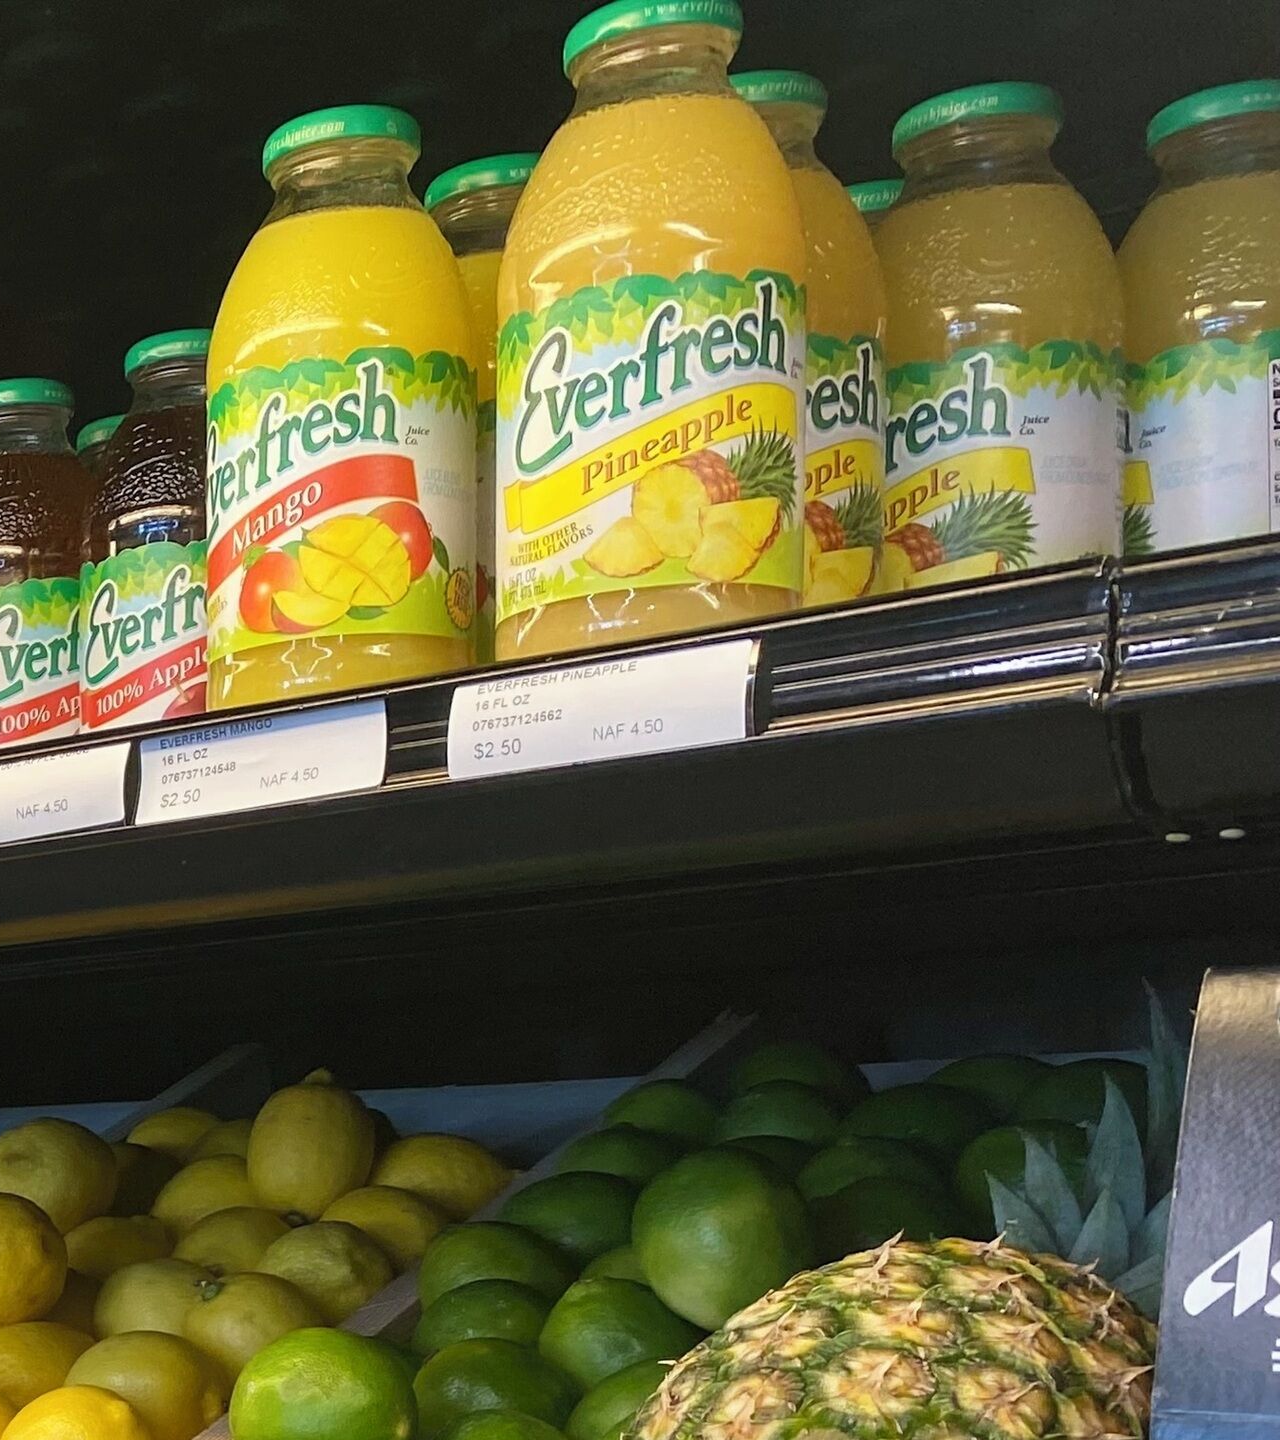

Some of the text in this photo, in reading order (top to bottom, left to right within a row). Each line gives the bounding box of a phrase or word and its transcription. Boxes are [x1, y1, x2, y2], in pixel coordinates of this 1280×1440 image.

[517, 278, 785, 474] Everfresh
[406, 426, 431, 437] Juice
[1021, 415, 1050, 426] Juice
[581, 394, 753, 496] Pineapple
[229, 480, 323, 558] Mango
[542, 522, 579, 547] OTHER
[547, 525, 595, 556] FLAVORS
[477, 675, 558, 695] EVERFRESH
[96, 681, 144, 717] 100%
[475, 694, 531, 712] 16 FL OZ
[472, 709, 563, 732] 076737124562
[160, 717, 274, 749] EVERFRESH MANGO
[473, 718, 665, 760] $2.50 NAF 4.50
[161, 748, 208, 767] 16 FL OZ
[259, 772, 289, 789] NAF
[290, 767, 320, 785] 4.50
[16, 804, 40, 820] NAF
[42, 798, 68, 815] 4.50
